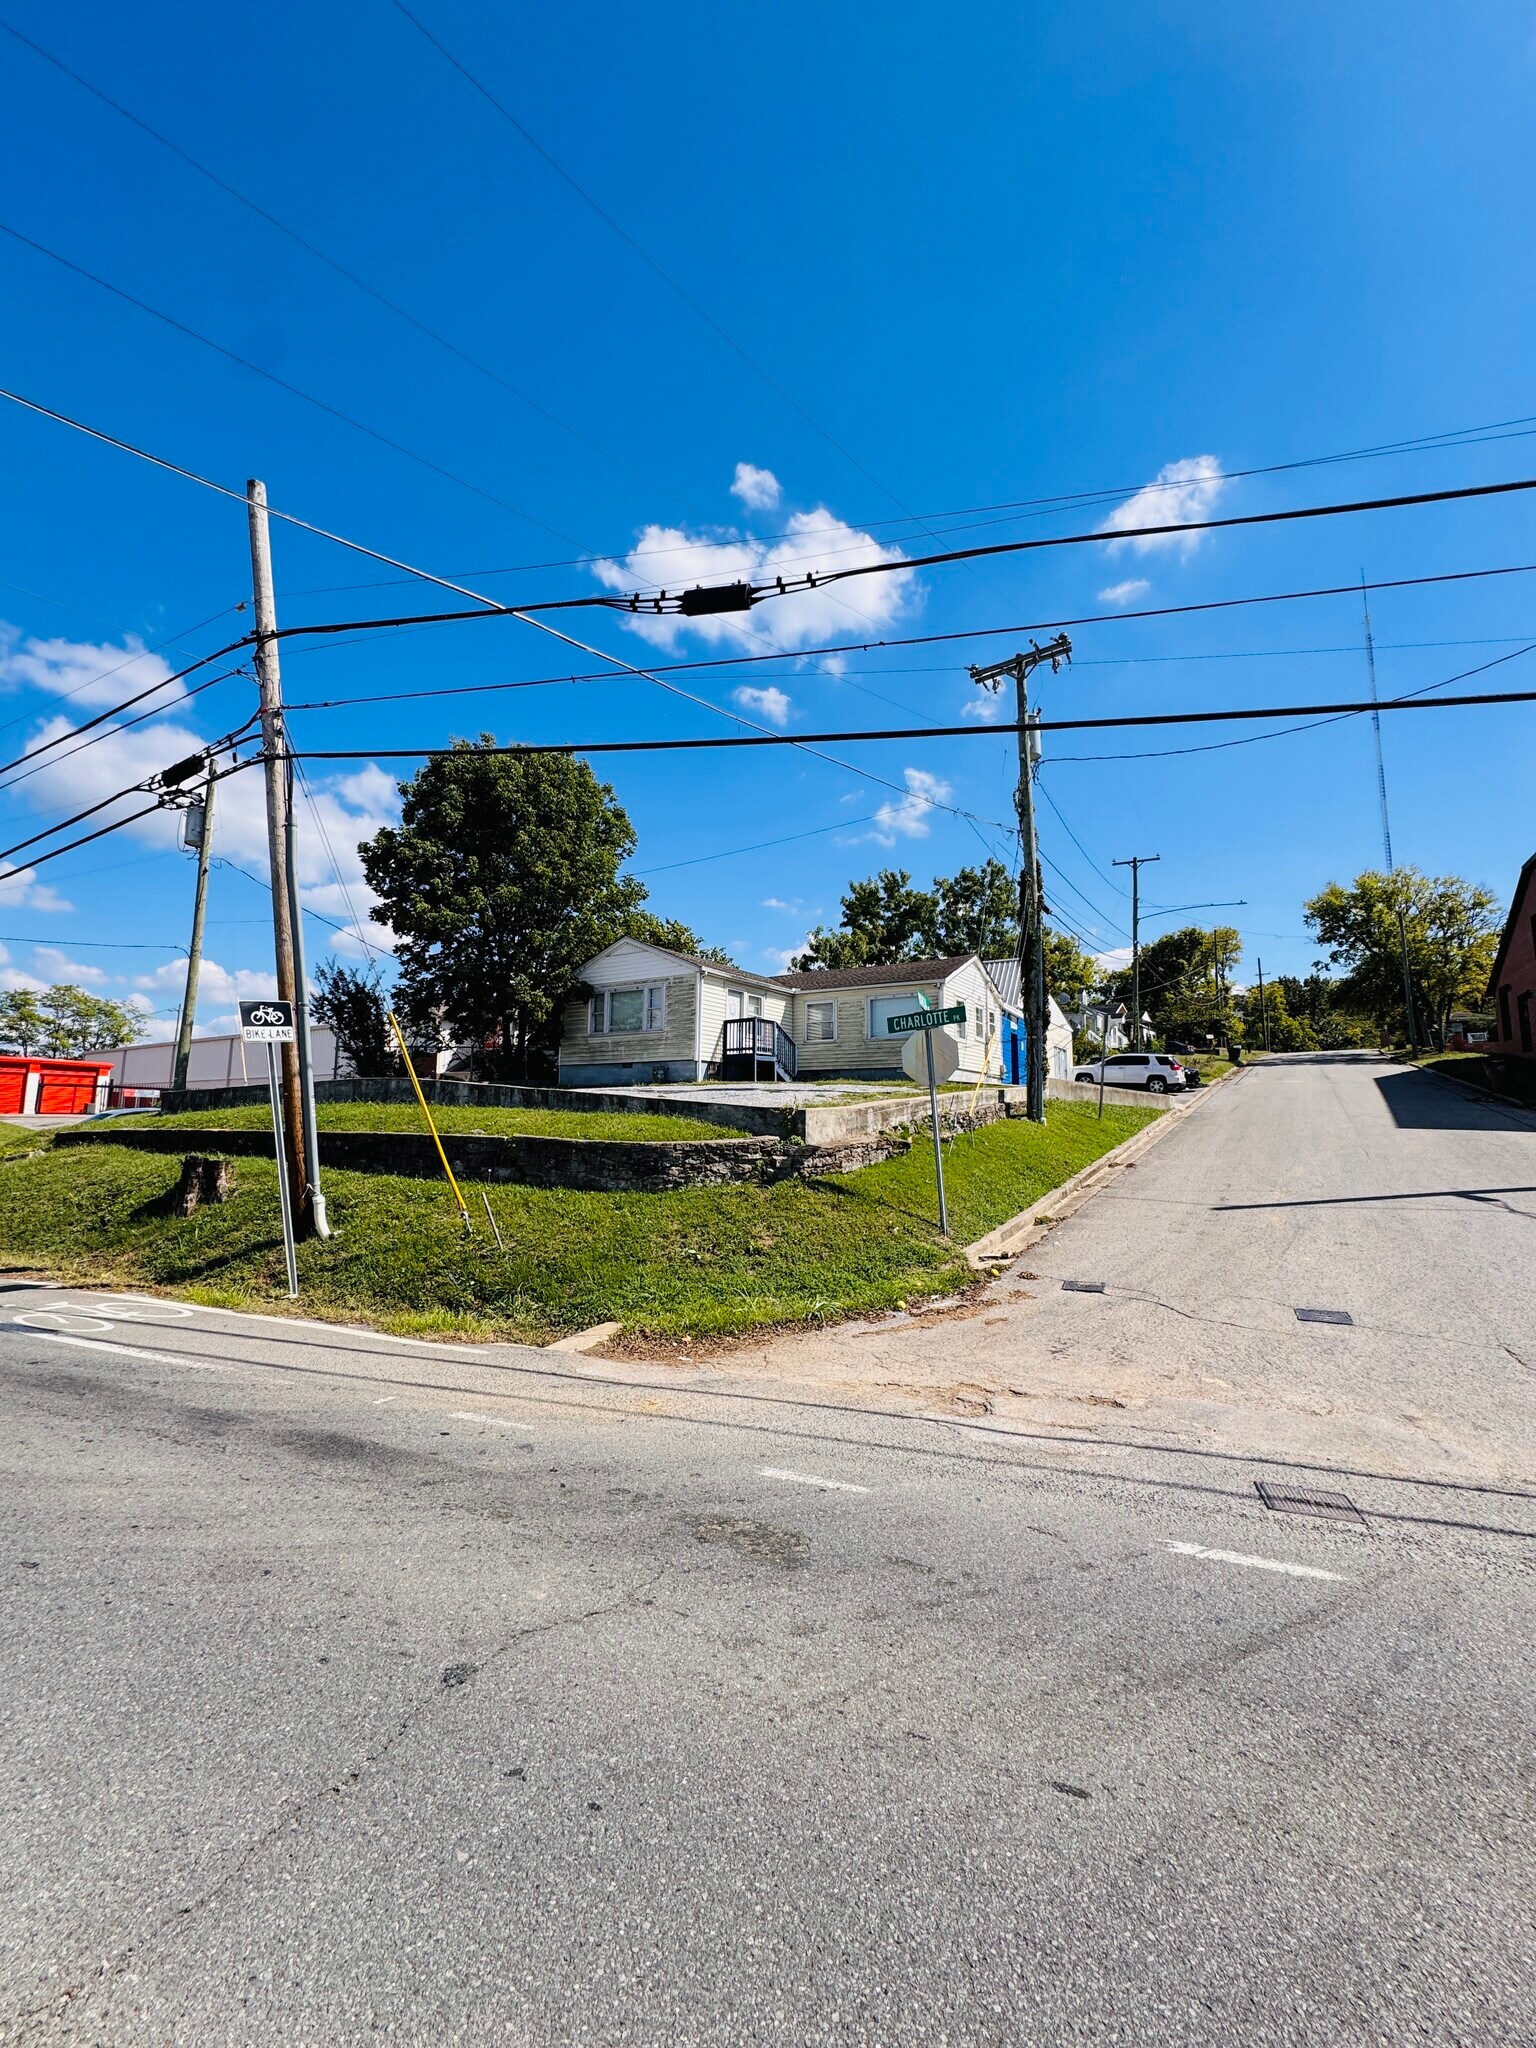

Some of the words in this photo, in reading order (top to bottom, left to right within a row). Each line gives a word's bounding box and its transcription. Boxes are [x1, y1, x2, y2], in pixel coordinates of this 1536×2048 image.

[893, 1010, 950, 1031] CHARLOTTE
[245, 1029, 266, 1039] BIKE
[269, 1029, 292, 1039] LANE
